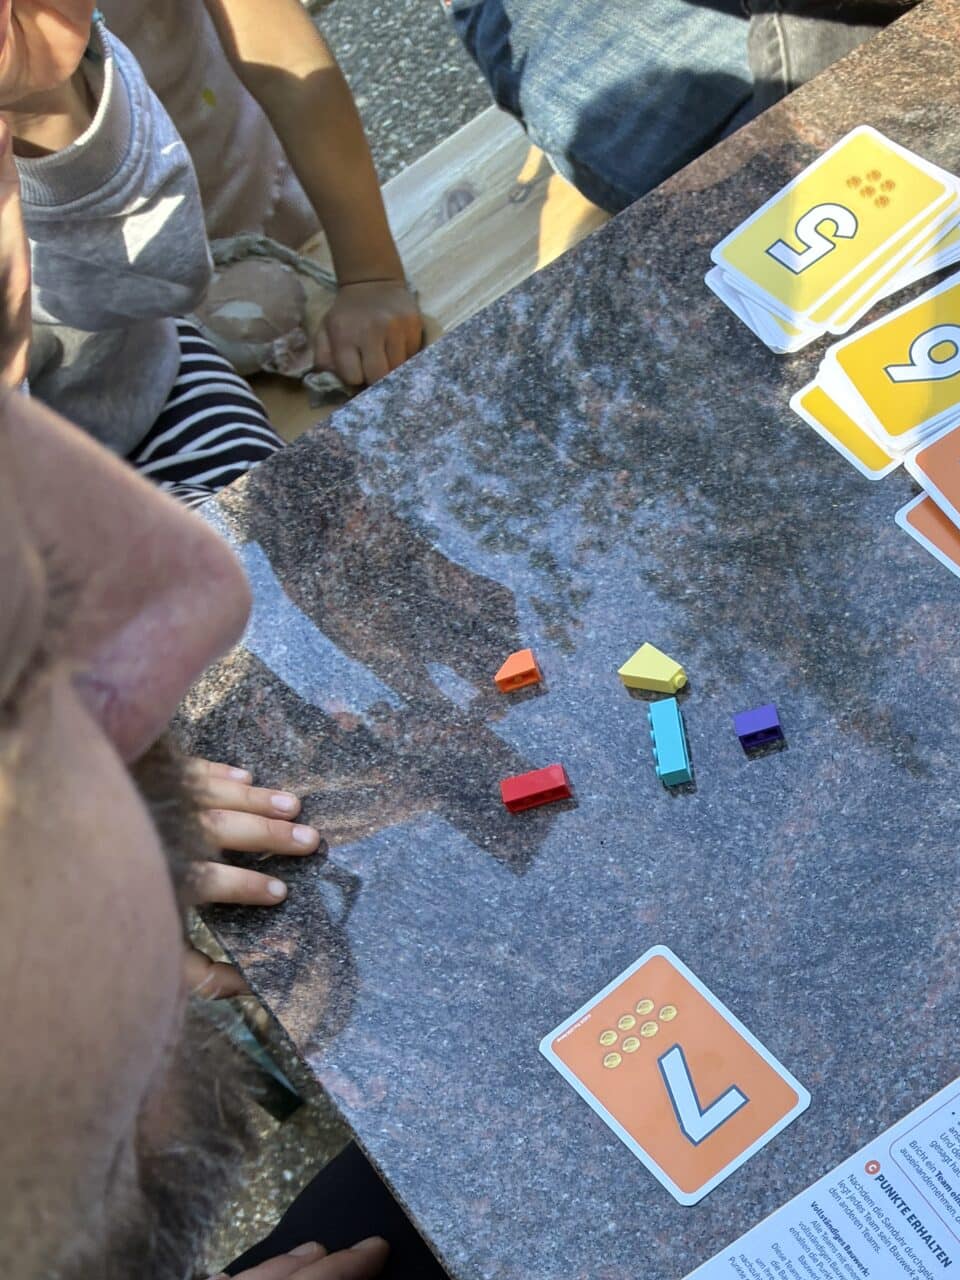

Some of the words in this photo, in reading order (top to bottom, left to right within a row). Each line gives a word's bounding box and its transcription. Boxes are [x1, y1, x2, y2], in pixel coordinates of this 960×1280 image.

[766, 203, 858, 275] 5
[657, 1043, 750, 1146] 7
[908, 1140, 929, 1162] Bricht
[925, 1160, 937, 1173] ein
[934, 1170, 953, 1193] Team
[810, 1200, 847, 1247] Vollständiges
[874, 1173, 912, 1216] PUNKTE
[906, 1213, 953, 1269] ERHALTEN
